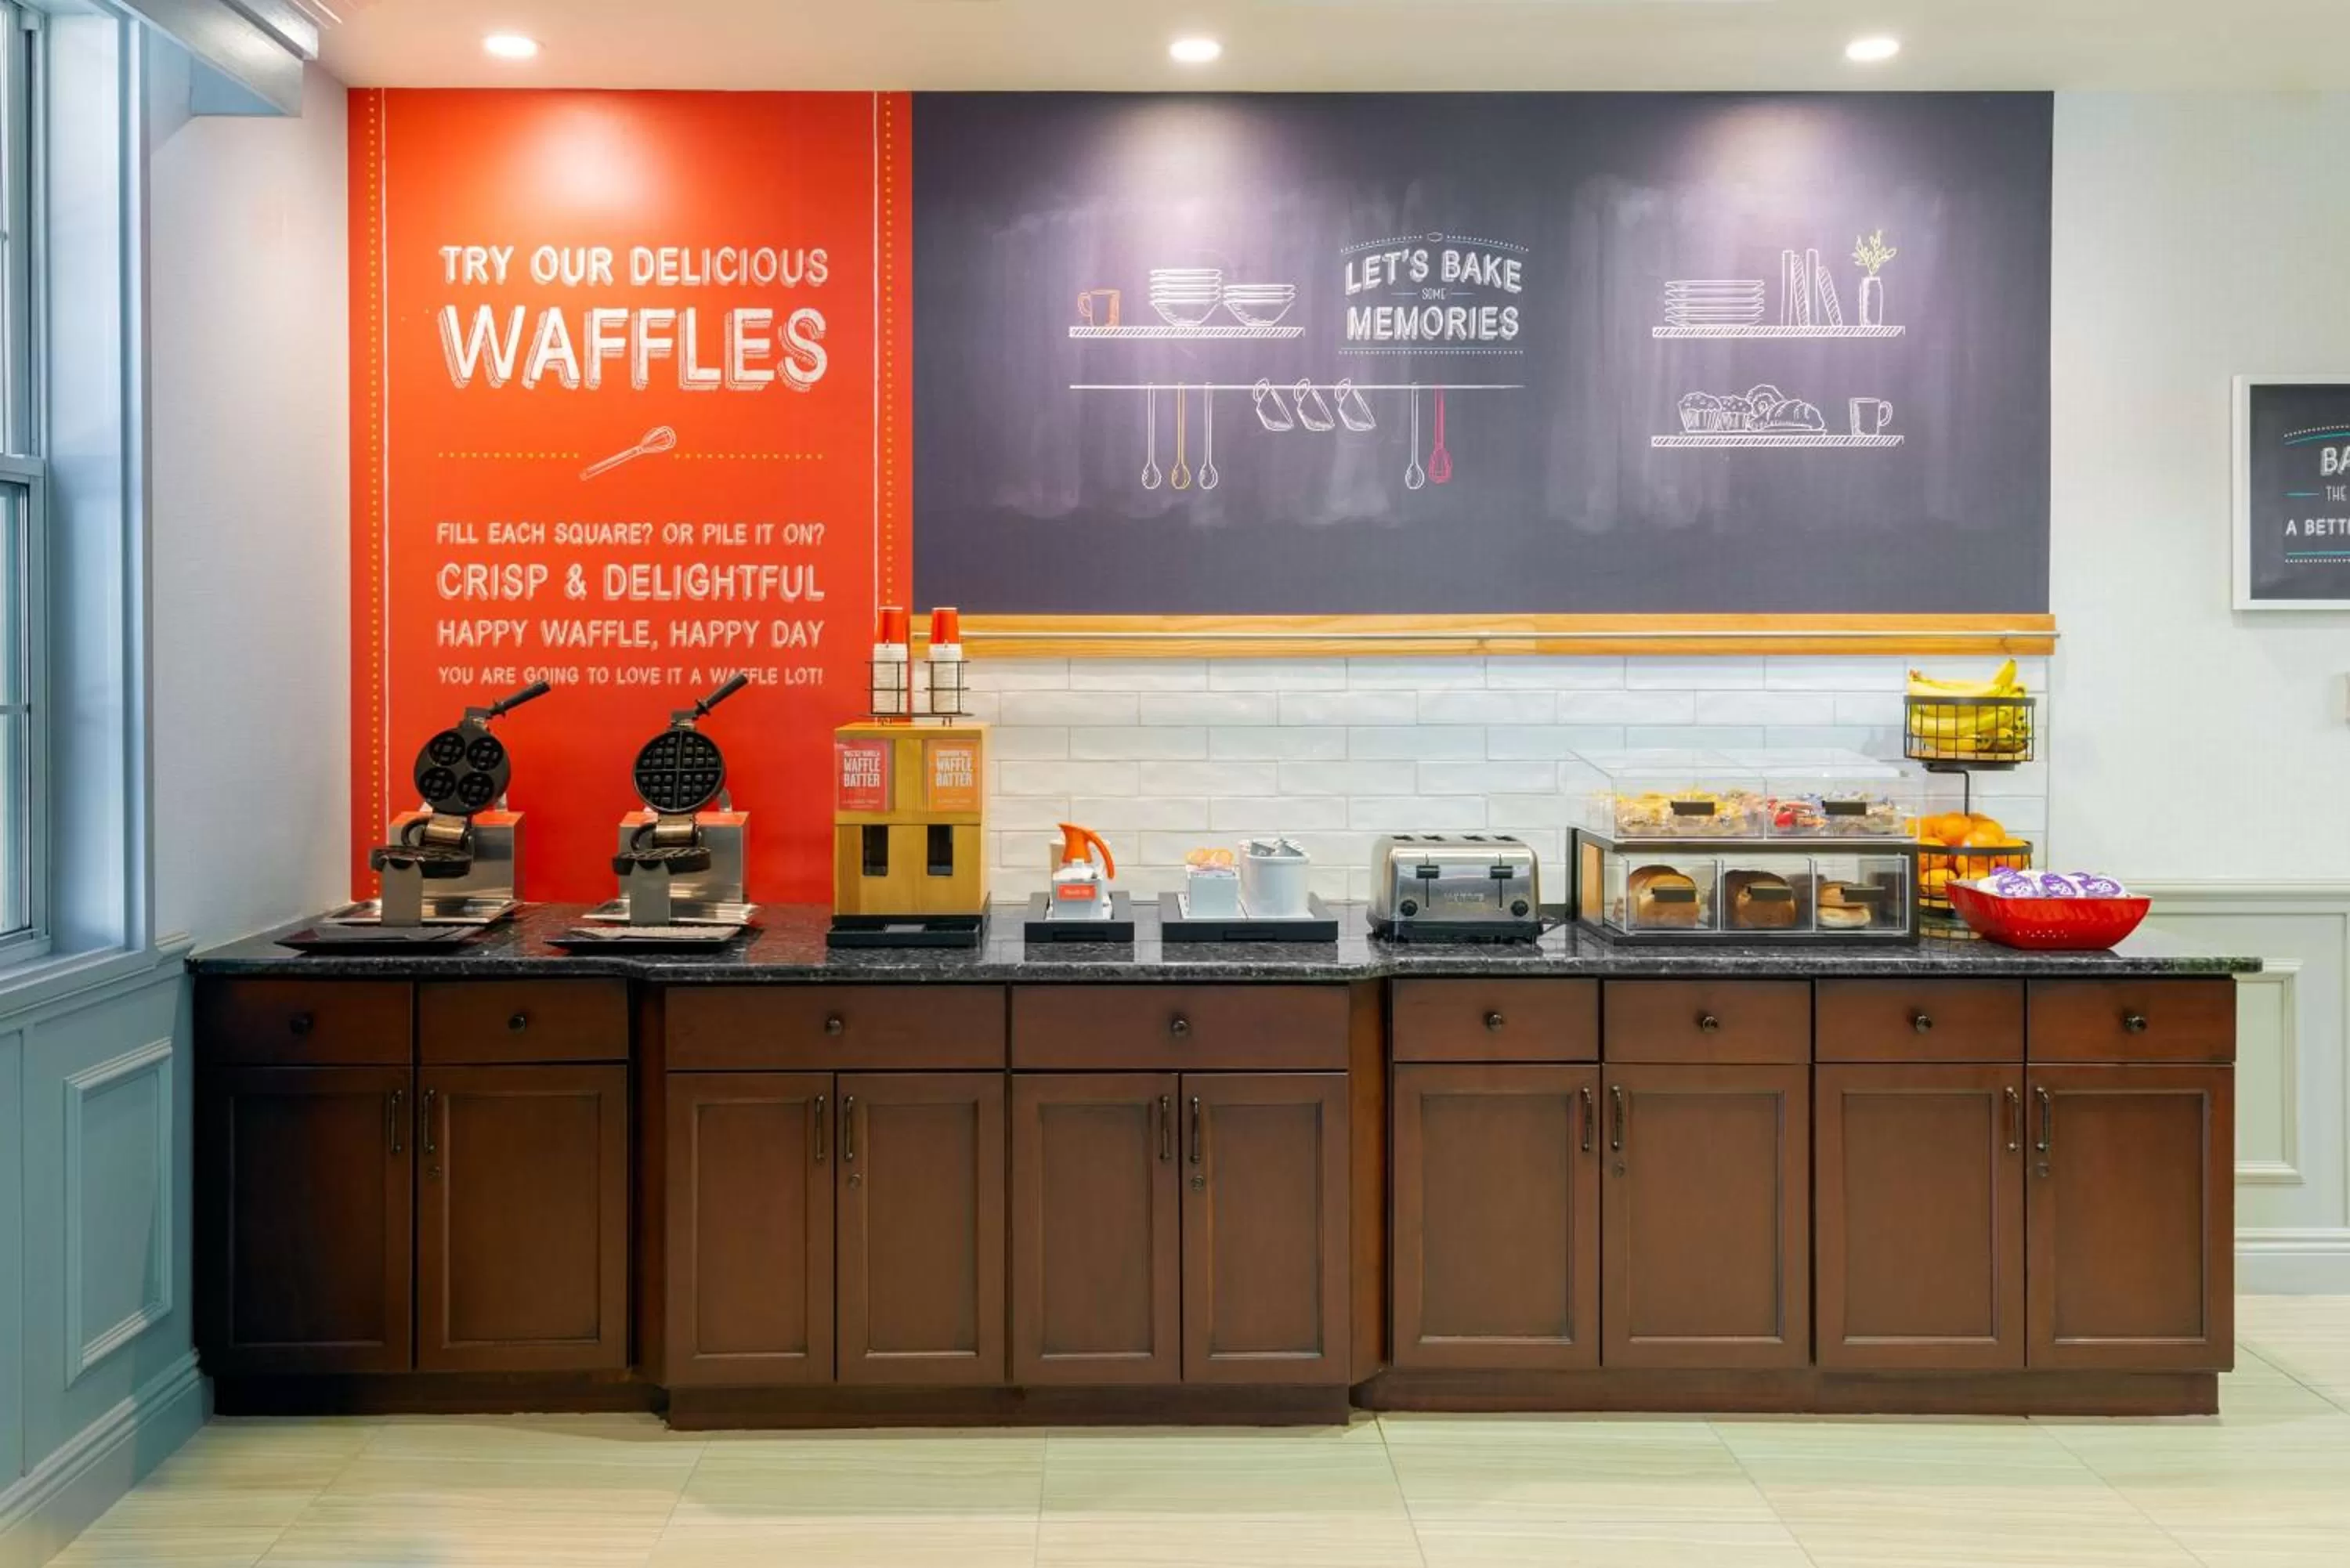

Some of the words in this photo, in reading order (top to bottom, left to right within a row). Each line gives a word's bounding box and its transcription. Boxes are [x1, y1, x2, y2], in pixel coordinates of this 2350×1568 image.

[439, 244, 515, 285] TRY
[530, 244, 614, 287] OUR
[630, 245, 829, 288] DELICIOUS
[1345, 248, 1430, 295] LET'S
[1441, 249, 1522, 294] BAKE
[1422, 287, 1447, 300] SOME
[1347, 305, 1520, 341] MEMORIES
[436, 303, 829, 392] WAFFLES
[2325, 485, 2347, 502] THE
[436, 522, 479, 546] FILL
[488, 522, 546, 546] EACH
[554, 522, 653, 547] SQUARE?
[662, 522, 694, 546] OR
[703, 522, 747, 546] PILE
[754, 522, 774, 546] IT
[783, 522, 825, 546] ON?
[2285, 518, 2298, 537] A
[436, 562, 549, 602] CRISP
[563, 562, 588, 602] &
[603, 563, 825, 603] DELIGHTFUL
[437, 620, 528, 649] HAPPY
[540, 620, 659, 651] WAFFLE,
[669, 620, 760, 649] HAPPY
[771, 620, 825, 649] DAY
[439, 667, 474, 685] YOU
[481, 667, 515, 685] ARE
[523, 667, 579, 685] GOING
[588, 667, 609, 685] TO
[616, 667, 661, 685] LOVE
[667, 667, 683, 685] IT
[690, 667, 702, 685] A
[784, 667, 824, 685] LOT!
[844, 757, 880, 772] WAFFLE
[844, 773, 880, 788] BATTER
